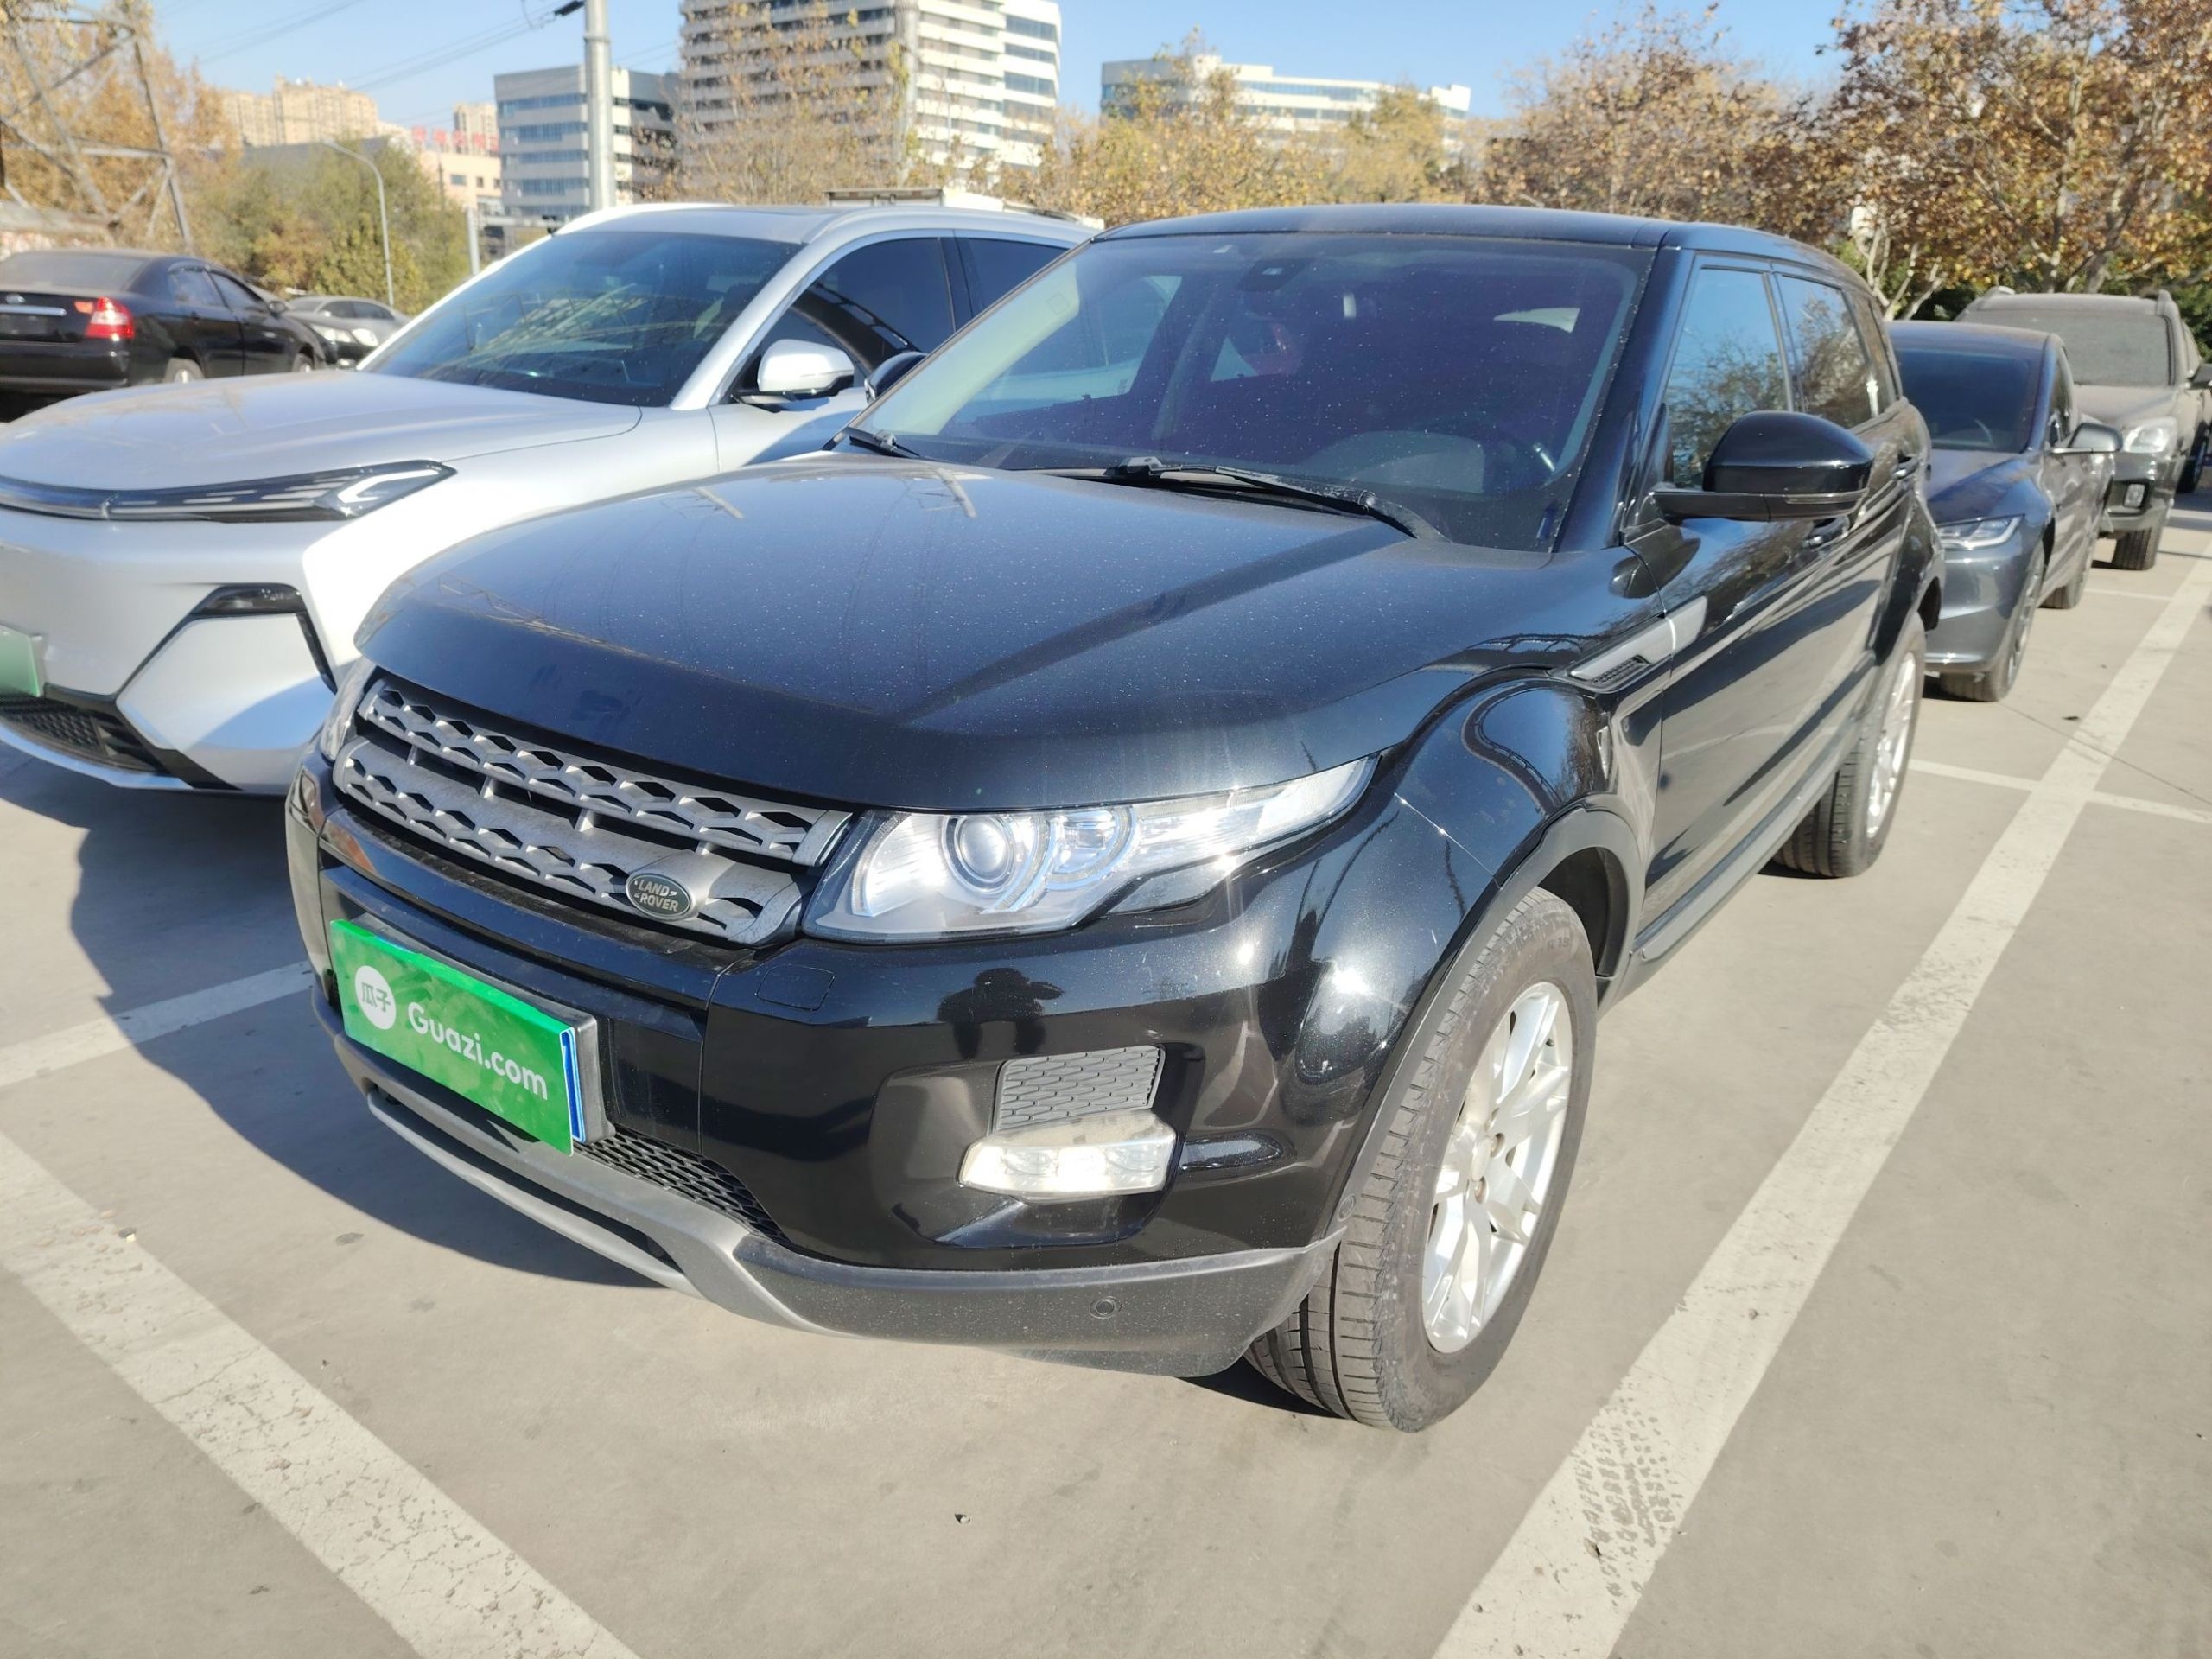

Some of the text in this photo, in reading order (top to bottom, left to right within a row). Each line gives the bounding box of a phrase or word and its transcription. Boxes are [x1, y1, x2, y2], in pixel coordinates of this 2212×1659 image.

[638, 880, 670, 897] LAND
[639, 893, 679, 912] ROVER
[361, 982, 391, 1013] 瓜子
[408, 1002, 548, 1101] Guazi.com
